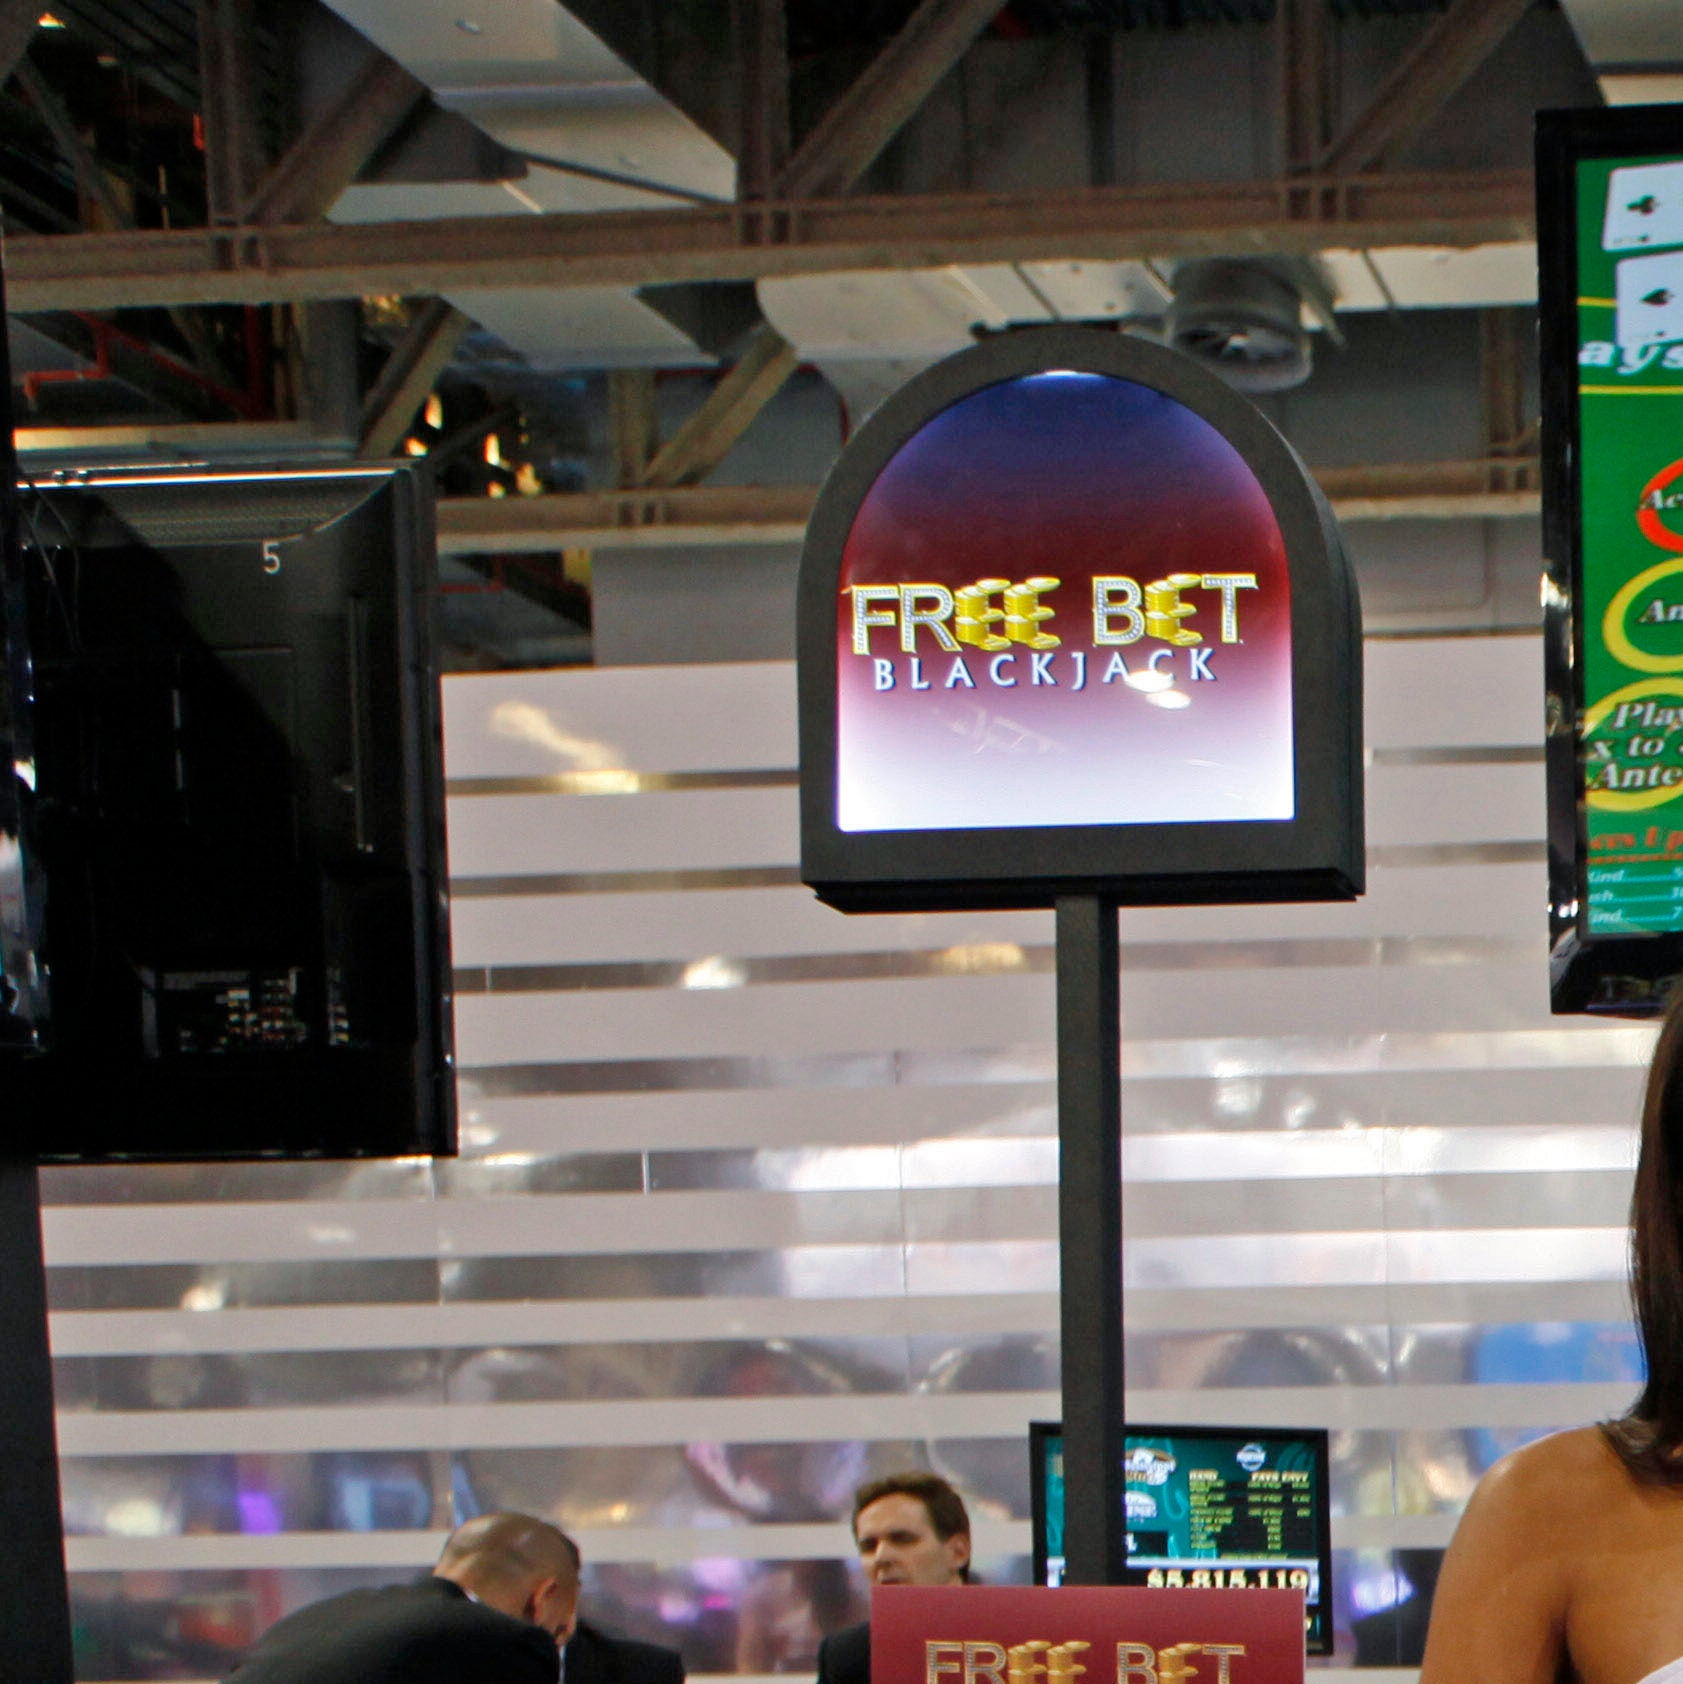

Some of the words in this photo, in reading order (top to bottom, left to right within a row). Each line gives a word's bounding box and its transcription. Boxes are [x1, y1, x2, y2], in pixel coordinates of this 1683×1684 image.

[263, 540, 281, 574] 5
[842, 575, 1061, 656] FREE
[1091, 572, 1259, 648] BET
[872, 648, 1217, 692] BLACKJACK
[1628, 734, 1665, 756] to
